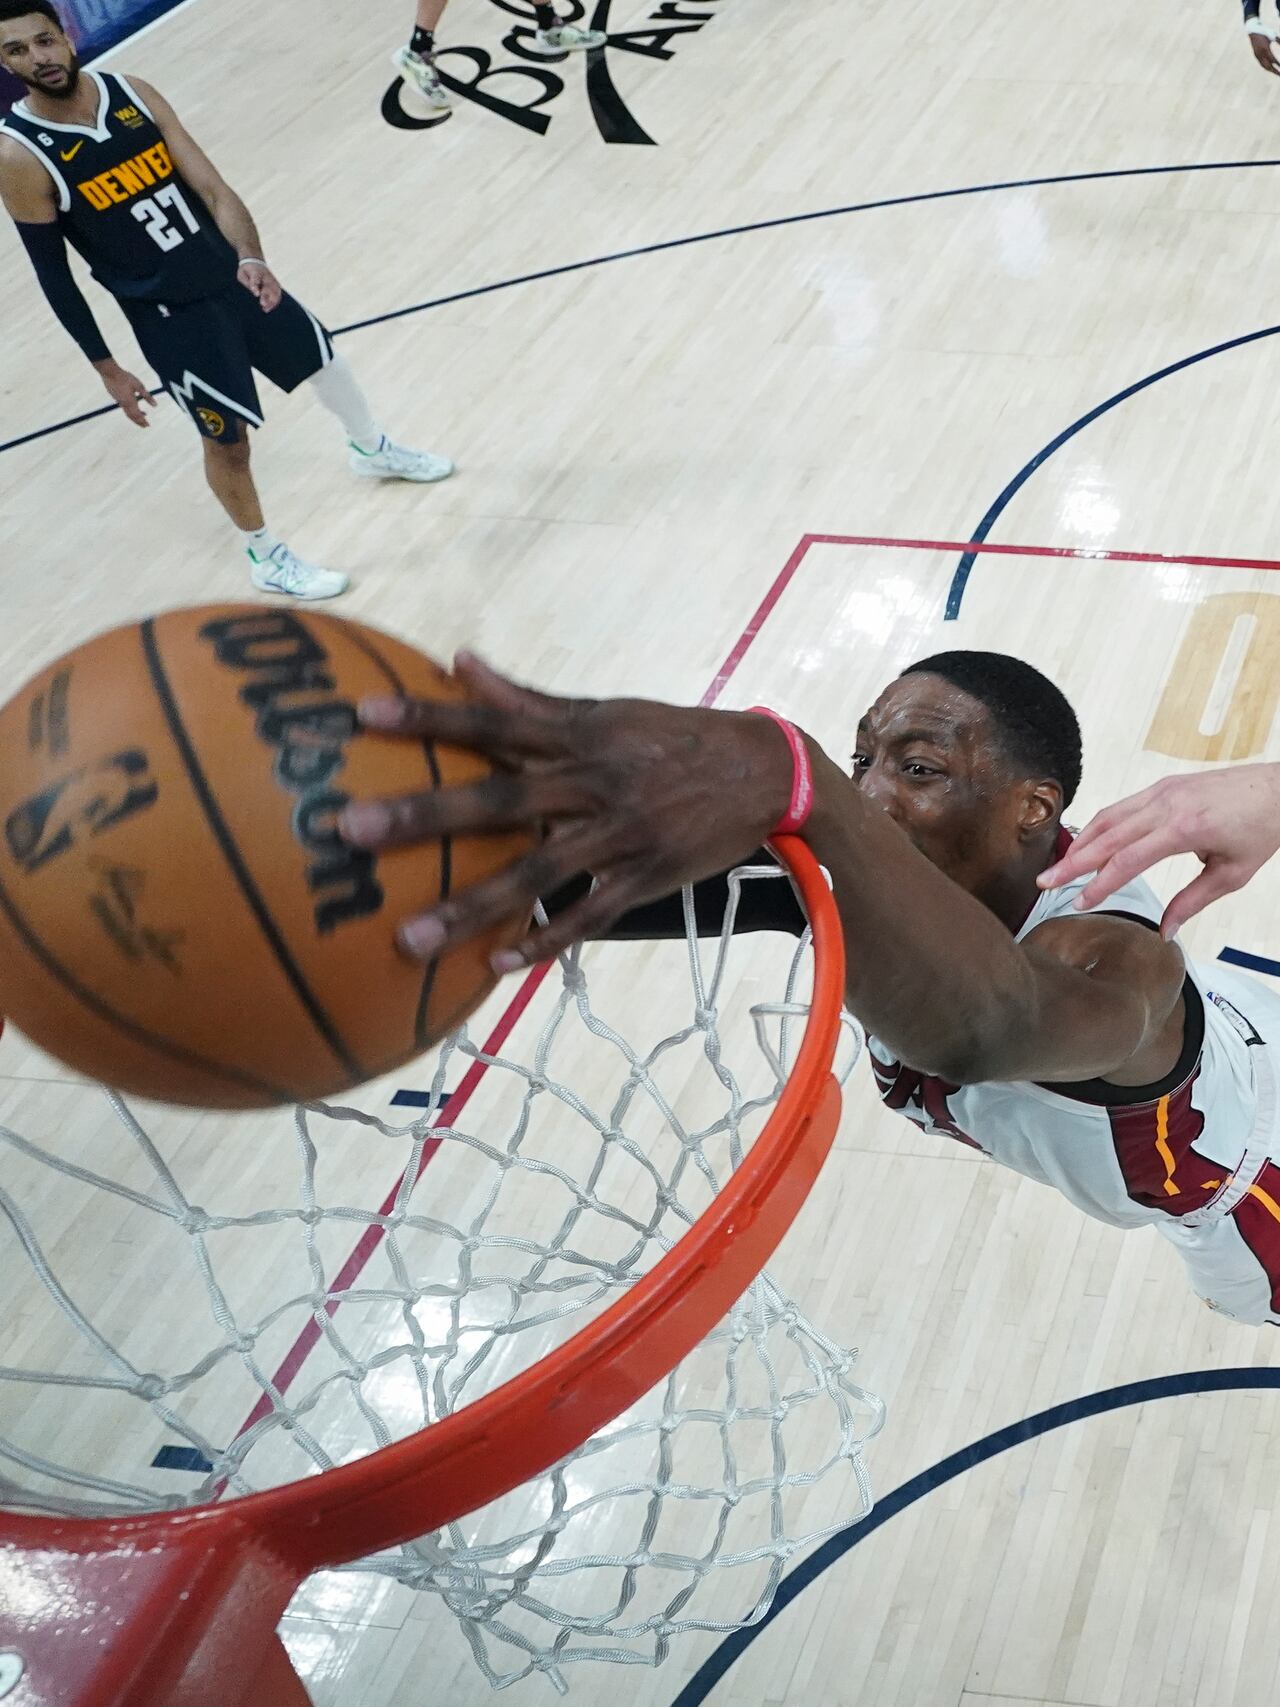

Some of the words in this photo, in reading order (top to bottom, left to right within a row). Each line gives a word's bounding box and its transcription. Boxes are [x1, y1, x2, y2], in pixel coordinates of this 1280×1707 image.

[37, 132, 54, 147] 6
[130, 182, 200, 253] 27
[199, 606, 384, 937] Wilson
